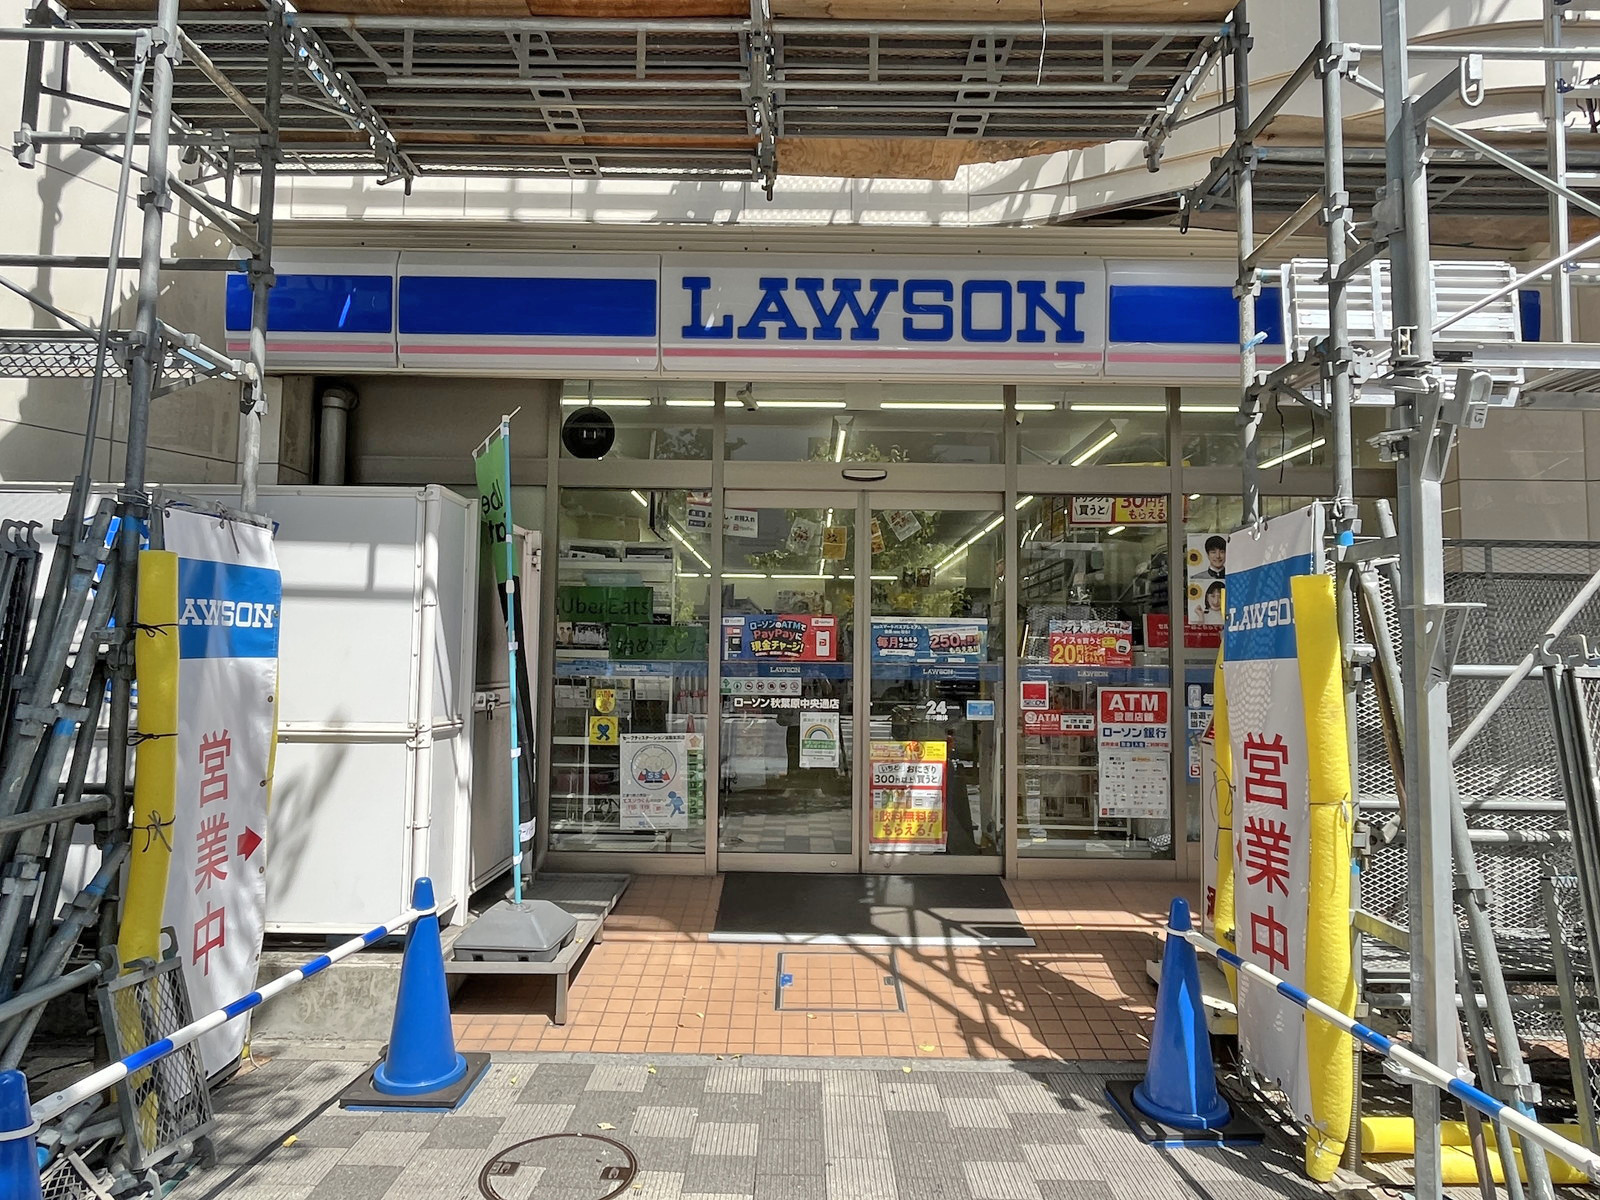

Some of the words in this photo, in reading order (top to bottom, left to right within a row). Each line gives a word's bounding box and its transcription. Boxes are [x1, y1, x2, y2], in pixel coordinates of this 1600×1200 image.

[681, 276, 1085, 344] LAWSON
[1079, 504, 1105, 516] 買うと
[1128, 509, 1166, 520] もらえる
[178, 598, 275, 629] AWSON
[1227, 597, 1296, 633] LAWSO
[925, 700, 947, 714] 24
[1107, 693, 1159, 711] ATM
[1036, 713, 1059, 722] ATM
[1102, 727, 1167, 739] ローソン銀行
[882, 823, 935, 837] もらえる!
[193, 729, 231, 977] 営業中
[1244, 732, 1293, 974] 営業中
